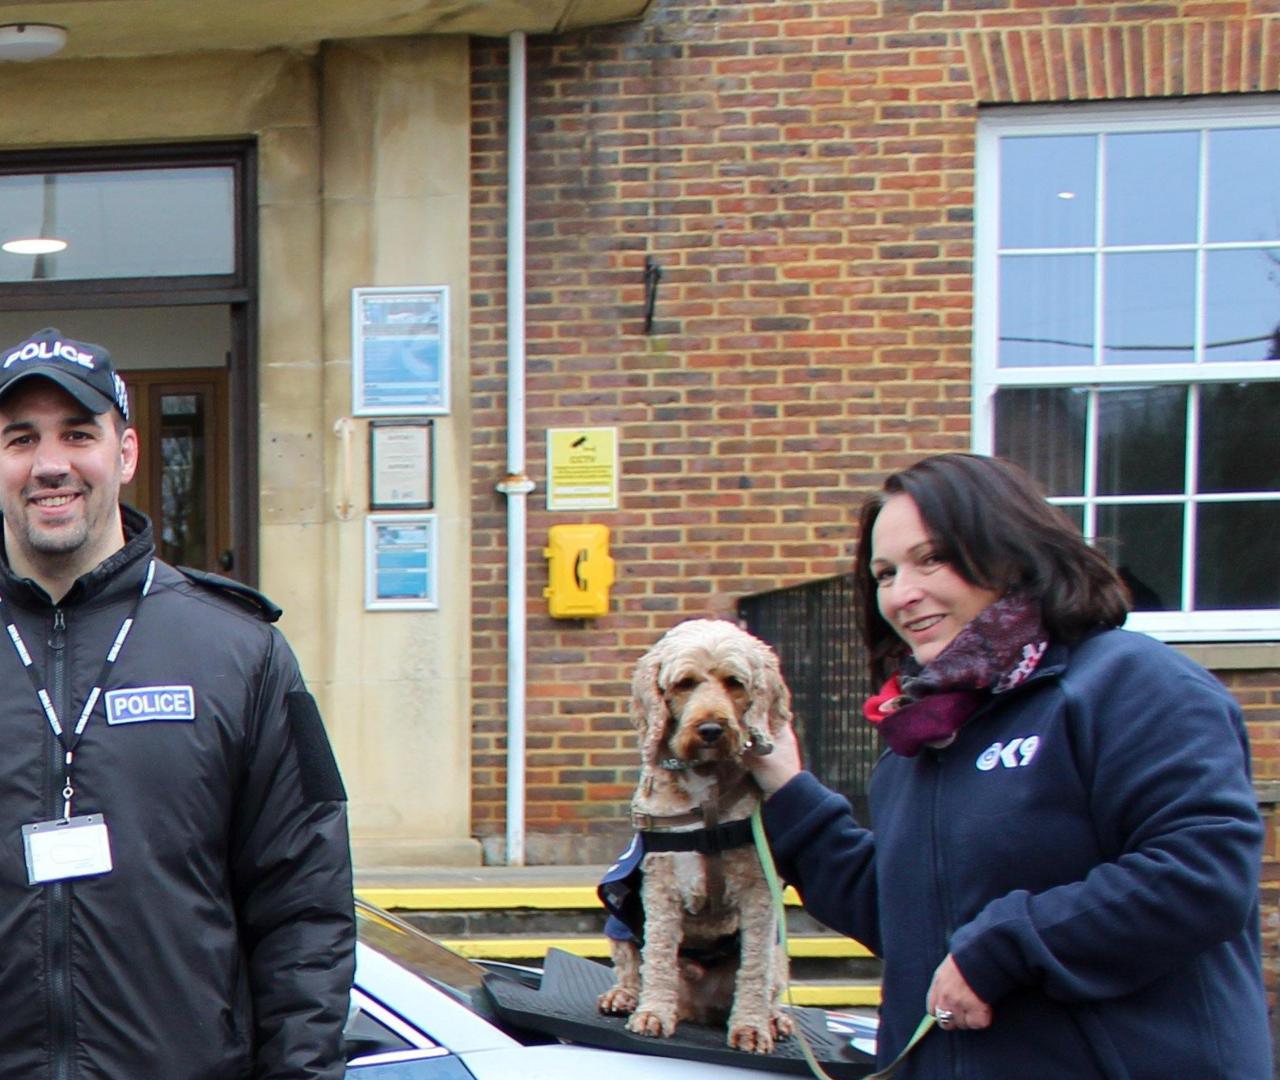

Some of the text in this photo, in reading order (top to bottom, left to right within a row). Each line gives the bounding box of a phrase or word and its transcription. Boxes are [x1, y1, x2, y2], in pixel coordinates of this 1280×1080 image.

[3, 341, 95, 369] POLICE
[114, 693, 187, 716] POLICE
[975, 735, 1040, 771] OK9
